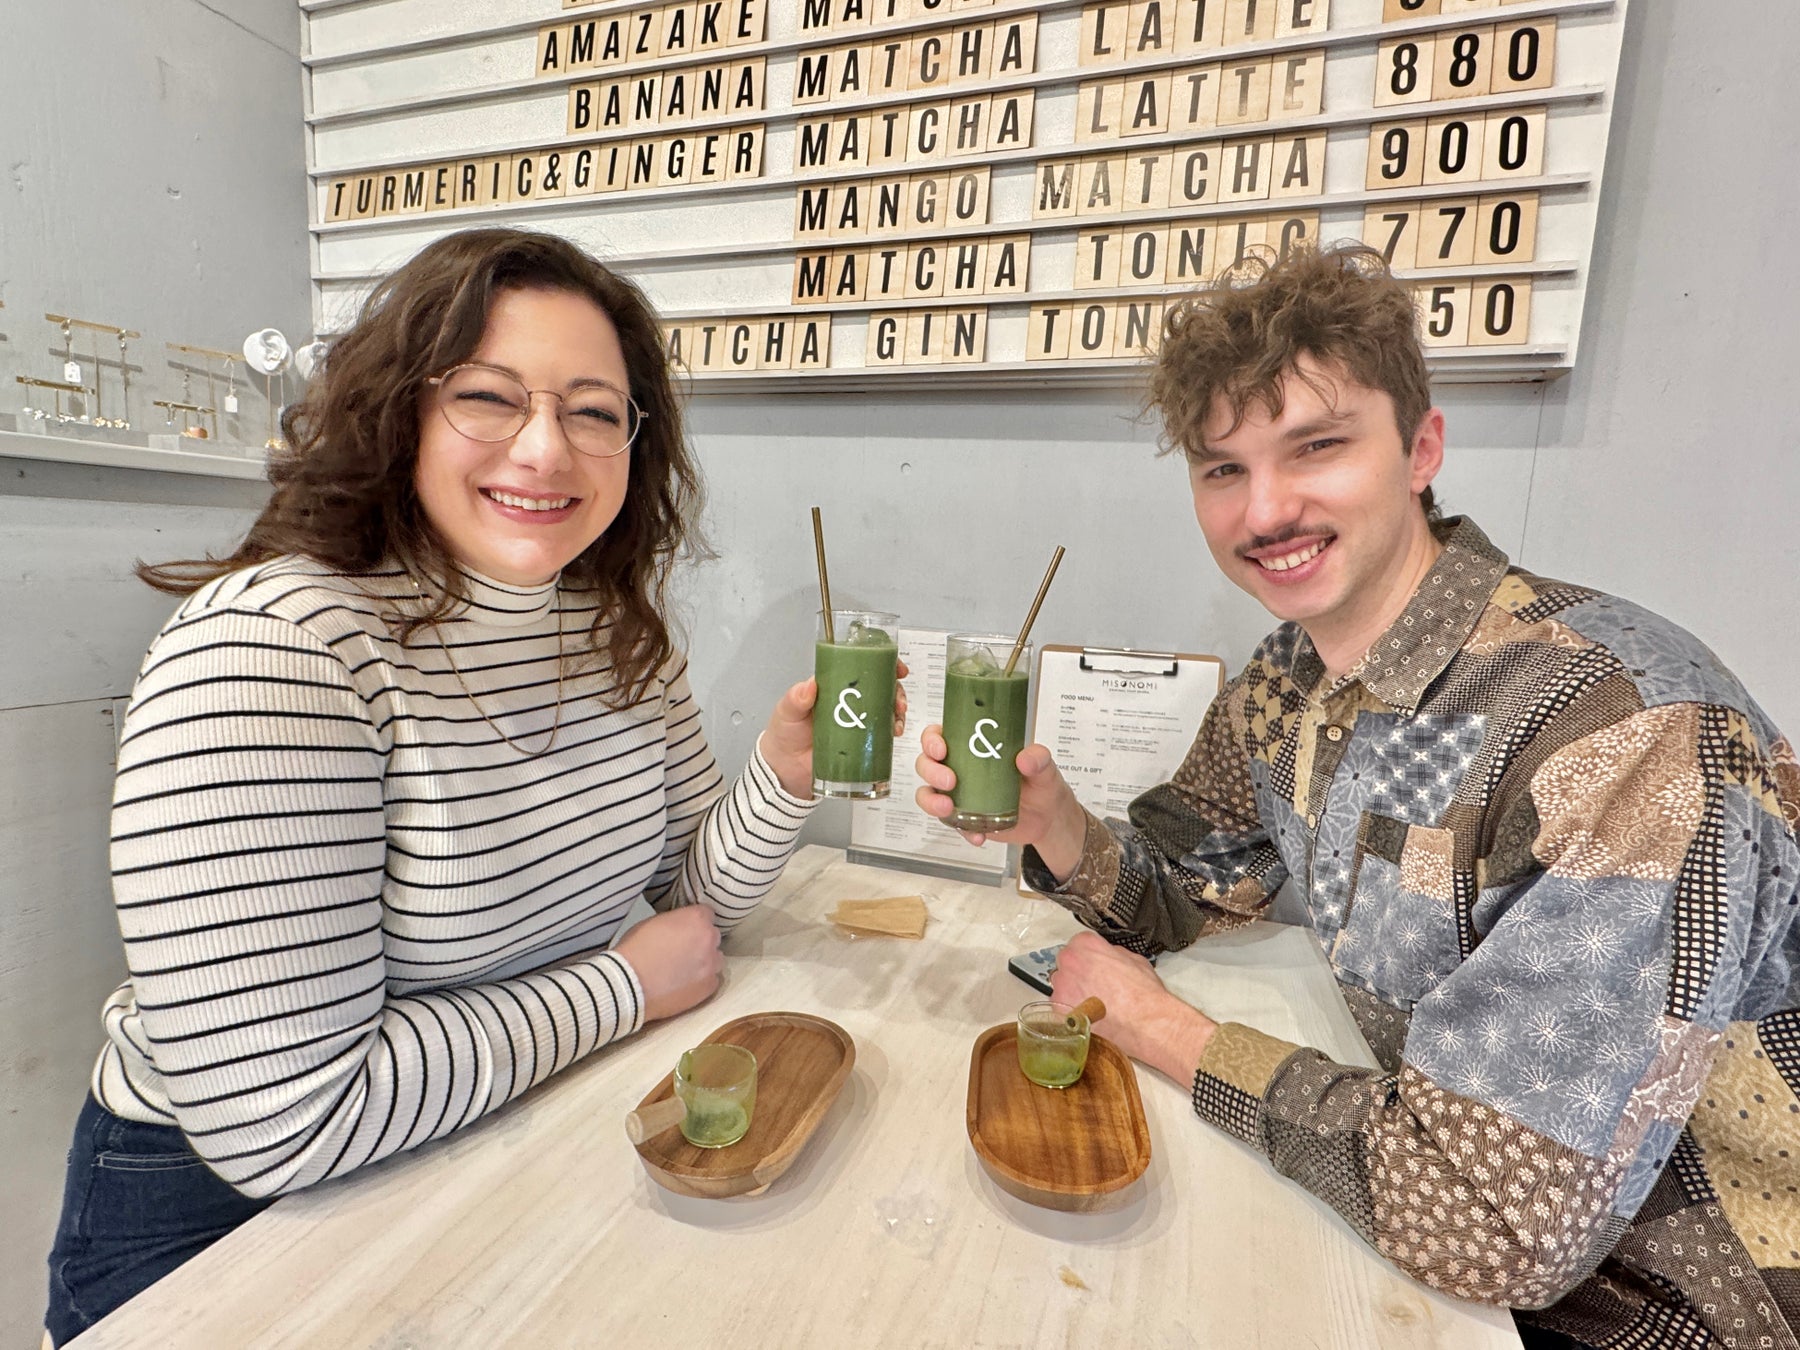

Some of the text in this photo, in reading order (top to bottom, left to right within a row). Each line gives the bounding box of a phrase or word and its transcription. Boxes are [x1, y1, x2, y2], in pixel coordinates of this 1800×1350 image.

[543, 0, 754, 70] AMAZAKE
[574, 66, 754, 130] BANANA
[798, 24, 1022, 98] MATCHA
[334, 27, 1540, 216] TURMERIC&GINGER MATCHA LATTE 880
[799, 116, 1529, 232] MANGO MATCHA 900
[798, 243, 1016, 298] MATCHA
[1382, 201, 1521, 266] 770
[669, 283, 1515, 366] ATCHA GIN TON 50
